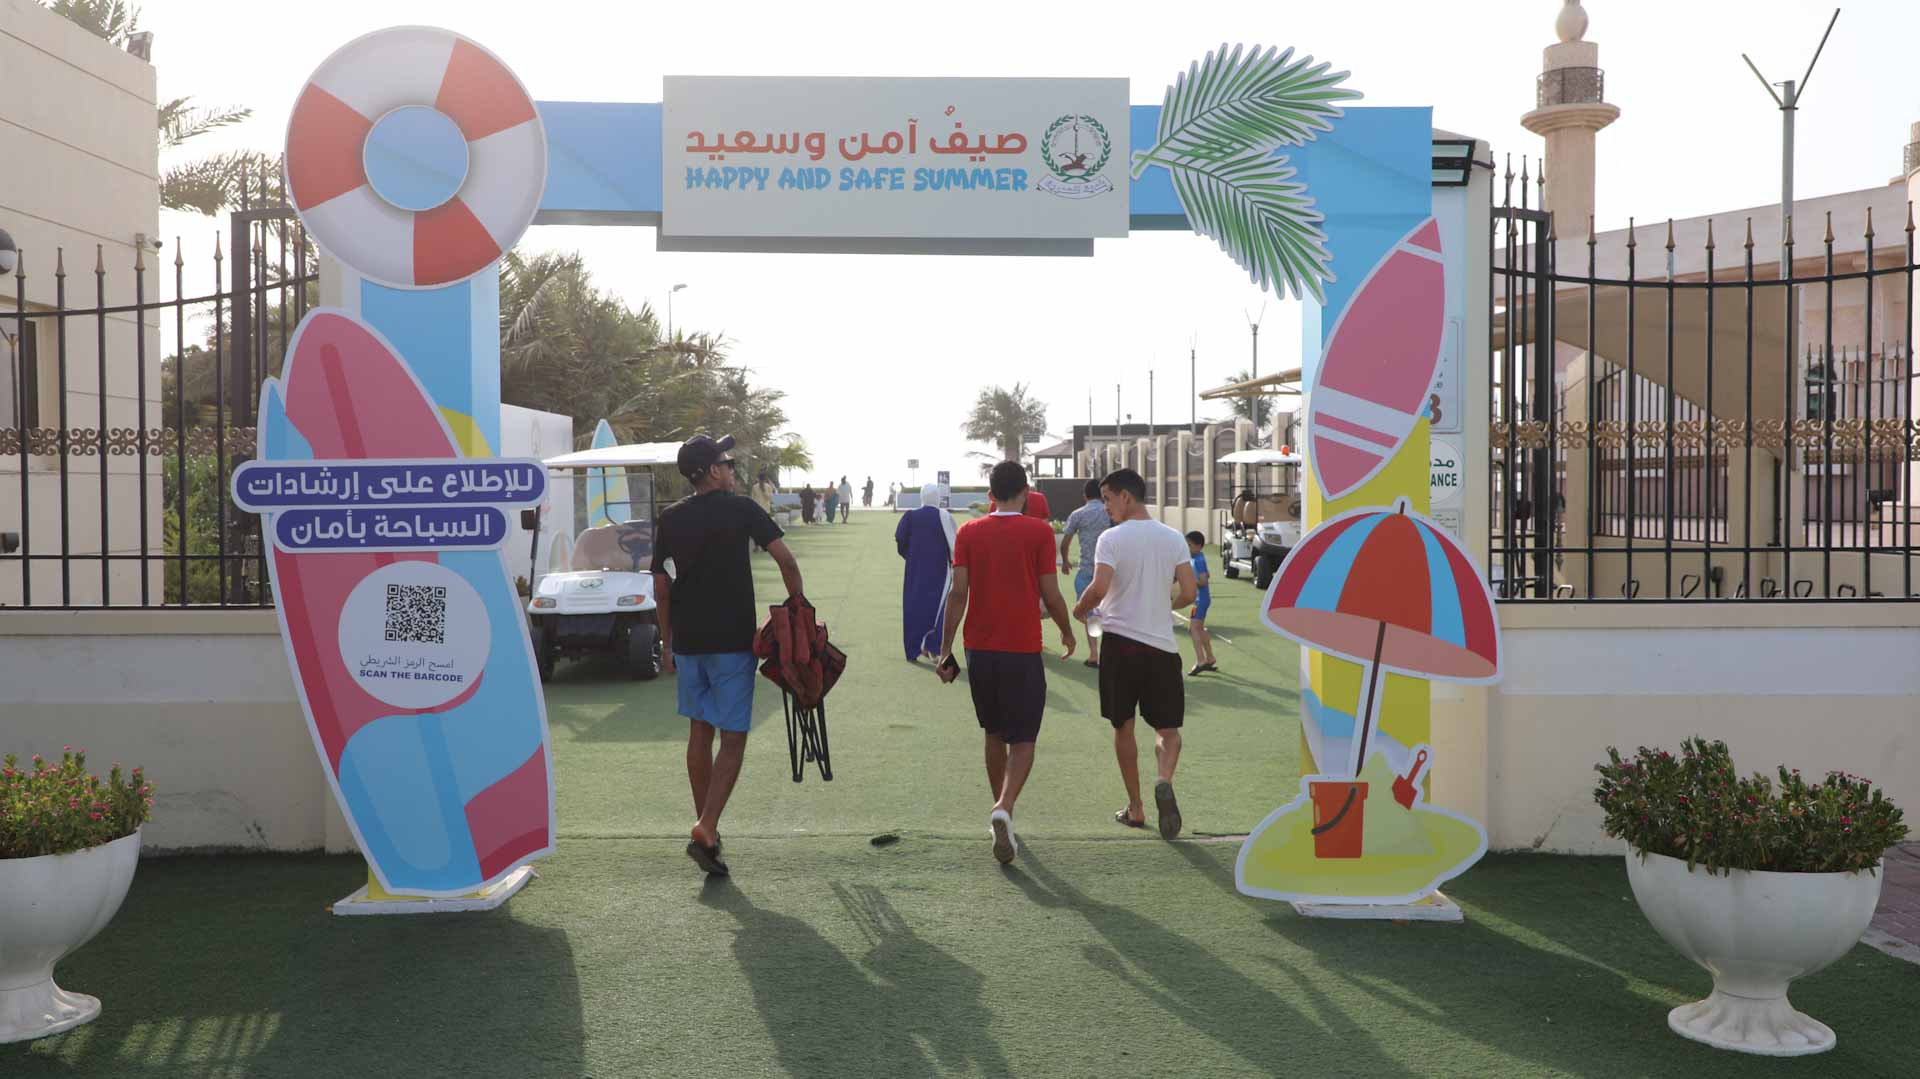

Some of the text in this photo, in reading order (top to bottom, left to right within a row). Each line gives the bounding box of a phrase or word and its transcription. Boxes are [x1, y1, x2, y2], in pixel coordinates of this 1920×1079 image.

[686, 130, 826, 161] وسعيد
[838, 118, 917, 160] آمن
[685, 167, 770, 191] HAPPY
[777, 167, 831, 191] AND
[839, 167, 904, 191] SAFE
[912, 167, 1029, 191] SUMMER
[247, 467, 533, 500] للإطلاع على إرشادات
[1430, 473, 1457, 487] ANCE
[290, 510, 490, 544] السباحة بأمان
[360, 669, 463, 682] SCAN THE BARCODE
[403, 658, 425, 669] الرمز
